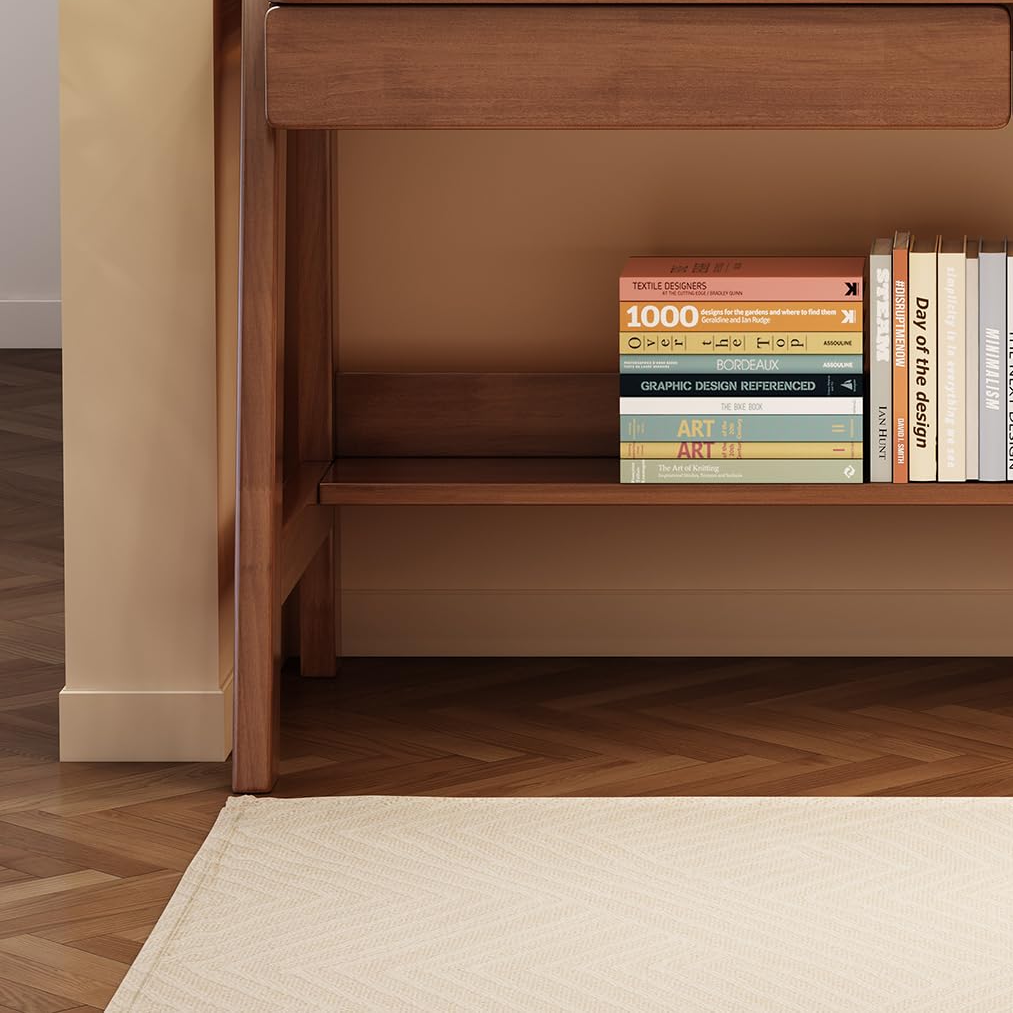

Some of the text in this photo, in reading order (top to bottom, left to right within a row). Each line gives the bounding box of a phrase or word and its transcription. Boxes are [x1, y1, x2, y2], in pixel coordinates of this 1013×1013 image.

[632, 281, 707, 290] TEXTILE DESIGNERS
[626, 305, 698, 328] 1000
[701, 308, 723, 317] designs
[723, 308, 732, 316] for
[733, 308, 744, 316] the
[744, 309, 769, 318] gardens
[769, 308, 781, 316] and
[781, 308, 799, 316] where
[807, 308, 819, 316] find
[820, 308, 837, 316] them
[751, 317, 771, 326] Rudge
[875, 267, 890, 362] STEAM
[895, 280, 906, 367] #DISRUPTMENOW
[627, 336, 804, 350] Over the Top
[716, 359, 779, 371] BORDEAUX
[913, 296, 930, 449] Day of the design
[985, 327, 1000, 410] MINIMALISM
[640, 380, 692, 391] GRAPHIC
[695, 380, 738, 391] DESIGN
[741, 380, 816, 391] REFERENCED
[721, 403, 763, 411] THE BIKE BOOK
[676, 419, 715, 438] ART
[879, 405, 888, 460] IAN HUNT
[897, 418, 905, 437] DAVID
[676, 442, 715, 458] ART
[897, 443, 905, 464] SMITH
[658, 464, 671, 472] The
[672, 464, 684, 472] Art
[684, 464, 692, 472] of
